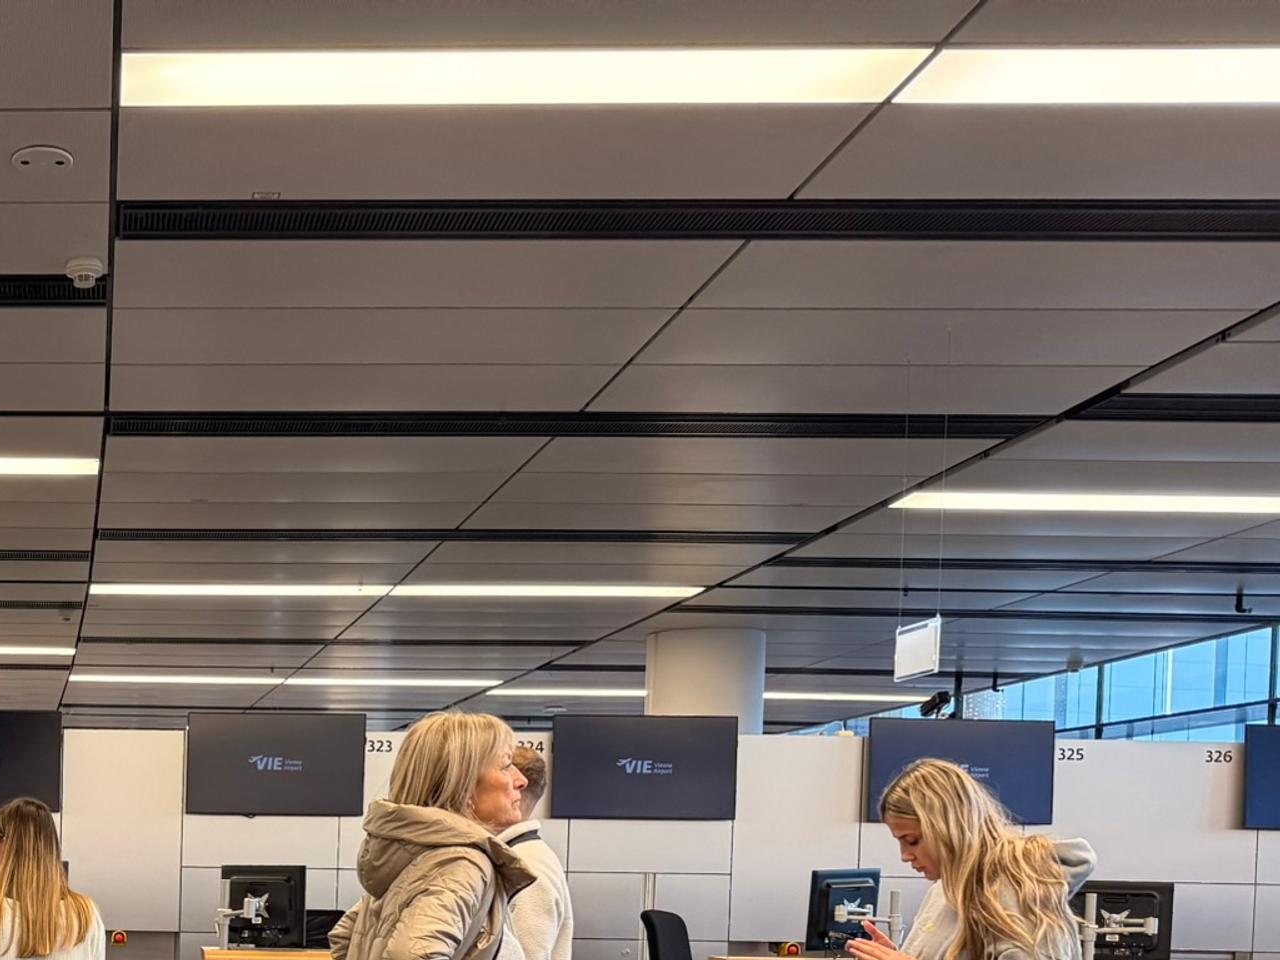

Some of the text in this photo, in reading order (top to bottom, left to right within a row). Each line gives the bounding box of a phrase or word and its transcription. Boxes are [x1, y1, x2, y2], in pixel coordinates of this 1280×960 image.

[367, 740, 392, 752] 323
[1057, 748, 1084, 761] 325
[1205, 750, 1233, 763] 326
[256, 757, 283, 770] VIE
[624, 760, 653, 774] VIE
